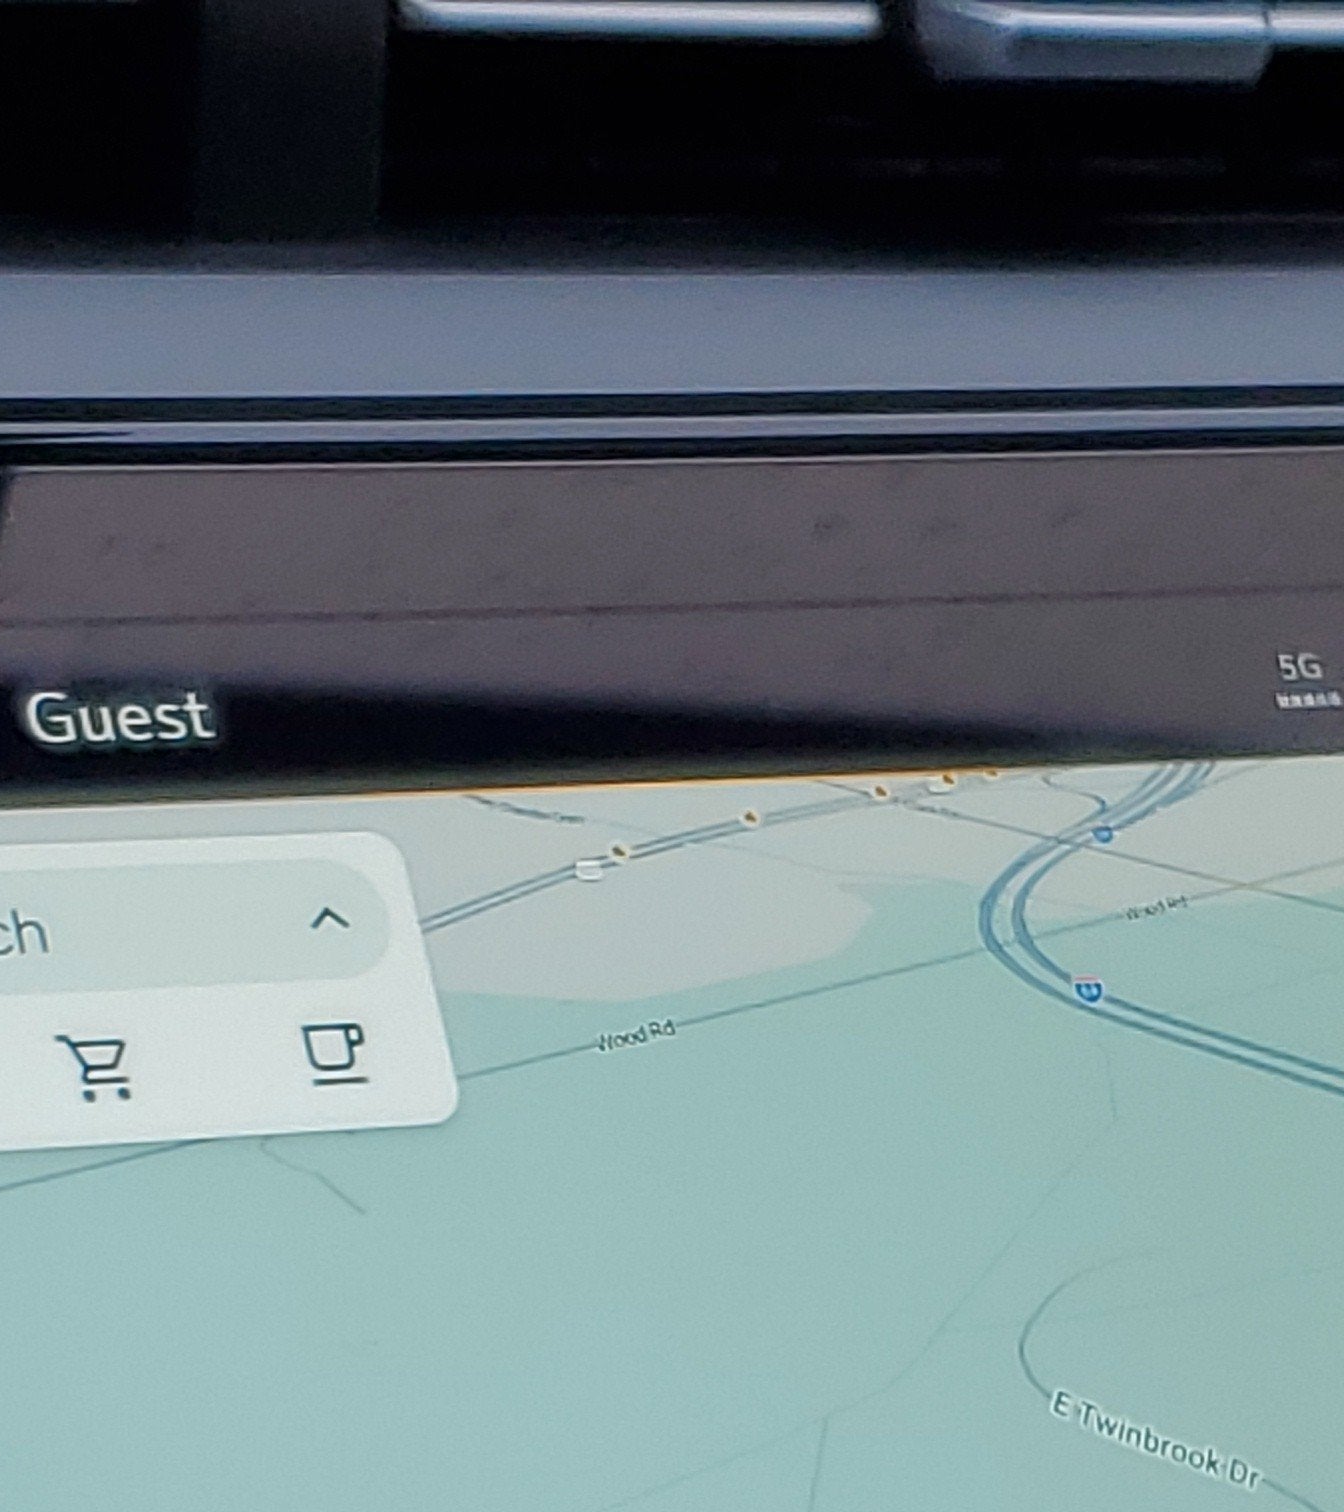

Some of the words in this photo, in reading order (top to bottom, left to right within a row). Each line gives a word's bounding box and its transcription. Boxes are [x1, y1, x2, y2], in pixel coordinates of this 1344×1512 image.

[1277, 652, 1325, 682] 5G
[25, 691, 218, 744] Guest
[648, 1018, 677, 1039] Rd
[1052, 1390, 1073, 1418] E
[1079, 1400, 1220, 1477] Twinbrook
[1229, 1457, 1260, 1489] Dr
